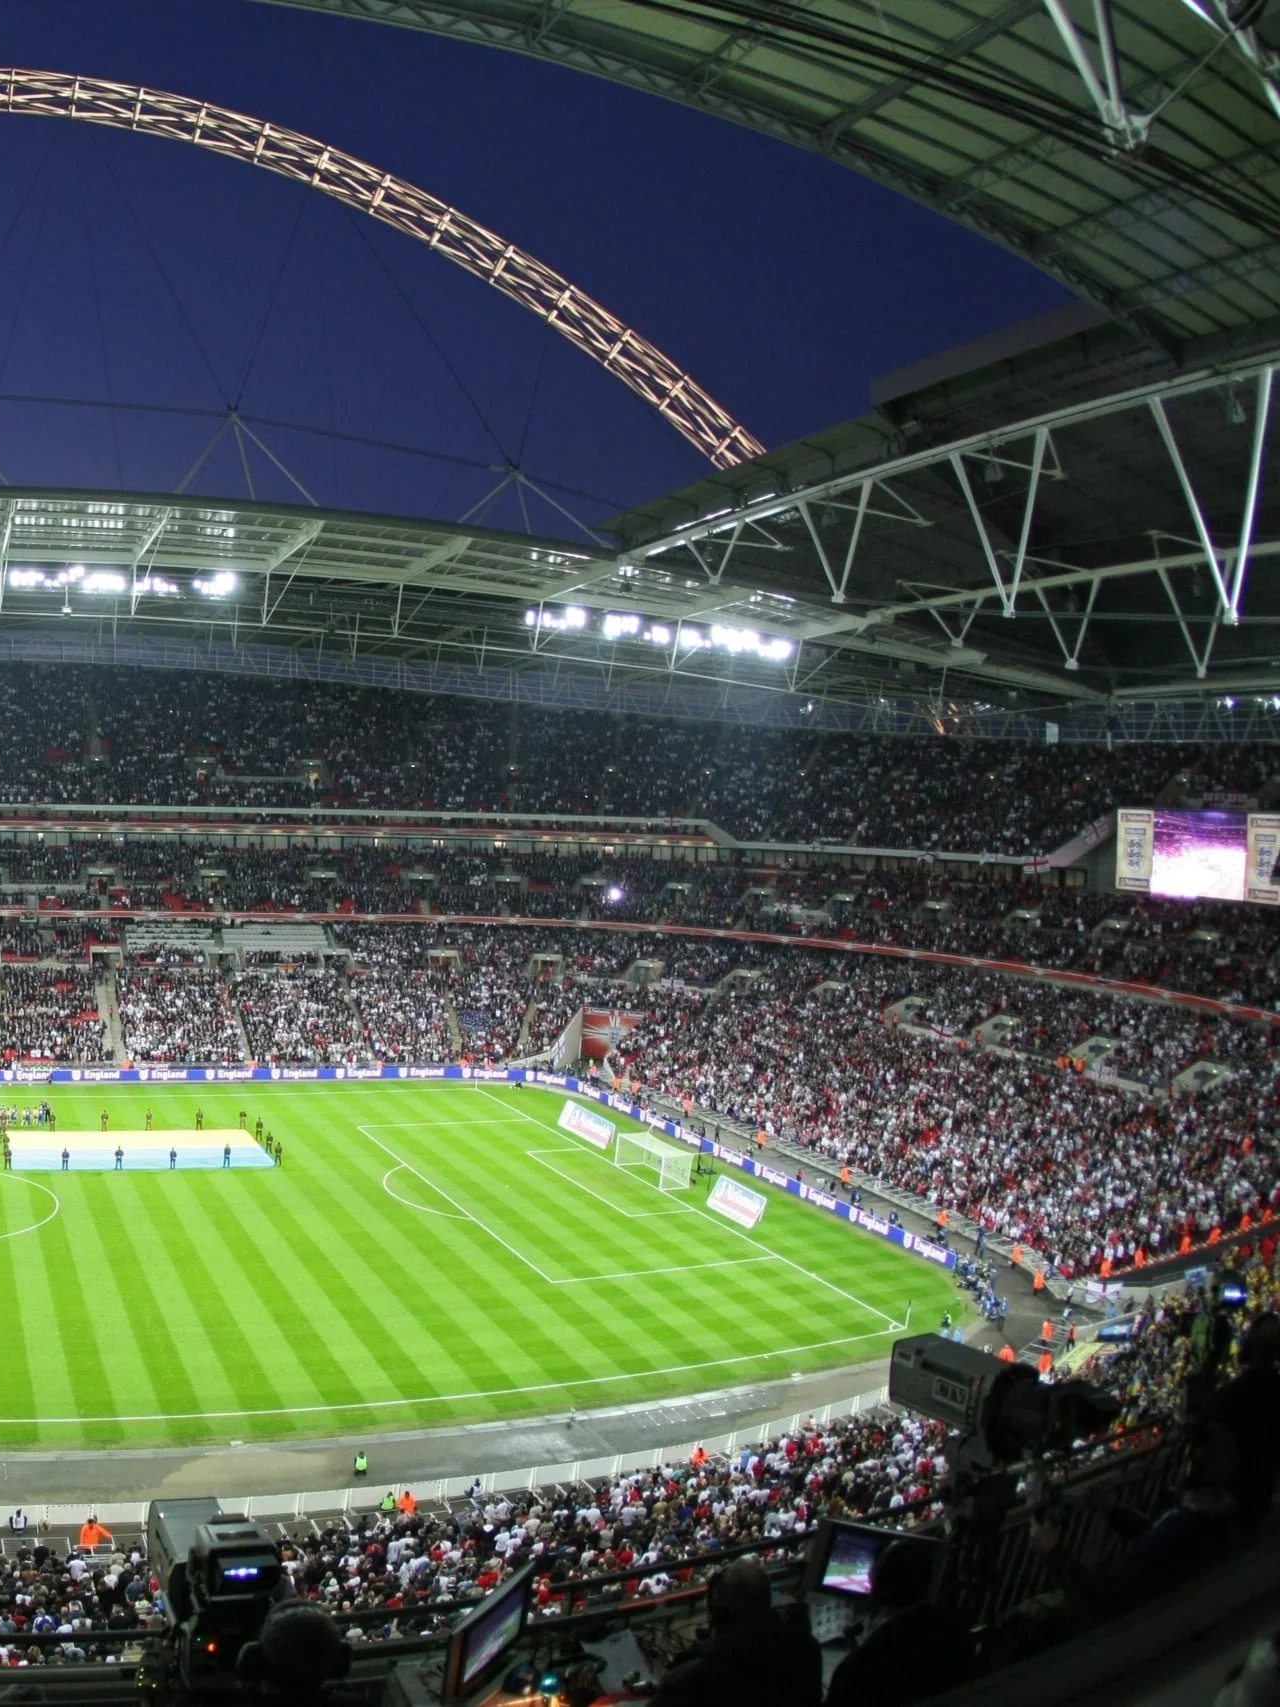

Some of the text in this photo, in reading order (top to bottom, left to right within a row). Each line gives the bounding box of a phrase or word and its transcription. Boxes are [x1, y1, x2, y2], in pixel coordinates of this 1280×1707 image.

[17, 1070, 51, 1080] Englan
[84, 1070, 119, 1080] England
[152, 1070, 187, 1080] England
[218, 1069, 252, 1079] England
[283, 1069, 317, 1079] England
[347, 1068, 382, 1078] England
[410, 1068, 444, 1078] England
[473, 1068, 507, 1079] England
[537, 1072, 566, 1085] England
[720, 1148, 744, 1166] England
[762, 1166, 787, 1187] England
[808, 1188, 836, 1210] England
[857, 1211, 889, 1235] England
[913, 1236, 946, 1263] England
